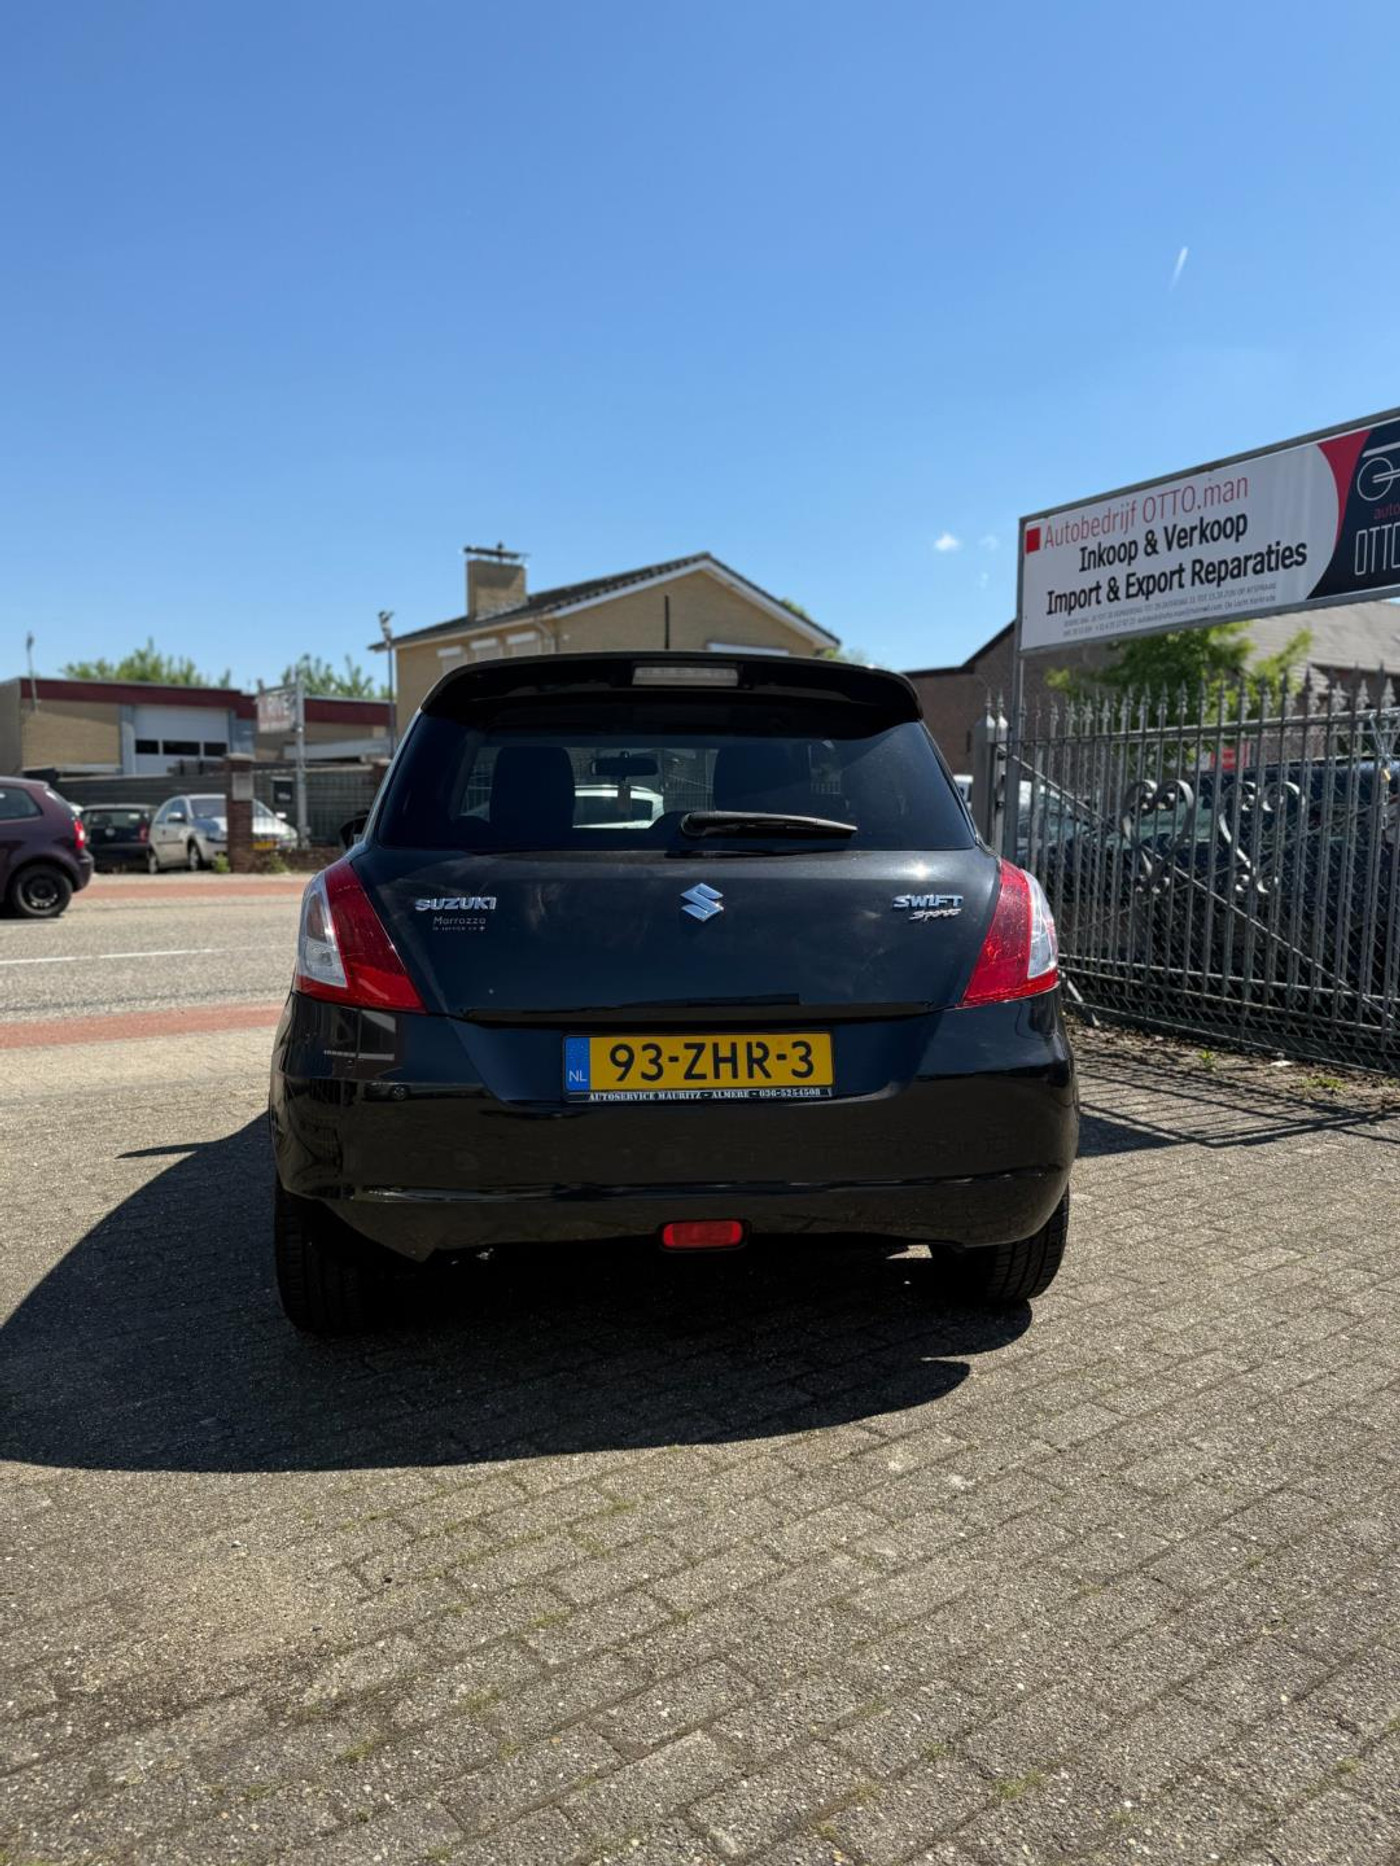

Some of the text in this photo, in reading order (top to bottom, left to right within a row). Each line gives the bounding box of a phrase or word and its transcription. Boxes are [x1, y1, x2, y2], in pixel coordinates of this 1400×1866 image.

[1044, 501, 1136, 549] Autobedrijf
[1079, 513, 1247, 572] Inkoop & Verkoop
[1047, 581, 1101, 616] Import
[1106, 576, 1120, 600] &
[1125, 562, 1185, 599] Export
[1191, 541, 1307, 587] Reparaties
[415, 897, 497, 911] SUZUKI
[892, 894, 964, 908] SWIFT
[609, 1041, 814, 1082] 93-ZHR-3
[569, 1071, 587, 1082] NL
[589, 1092, 655, 1101] AUTOSERVICE
